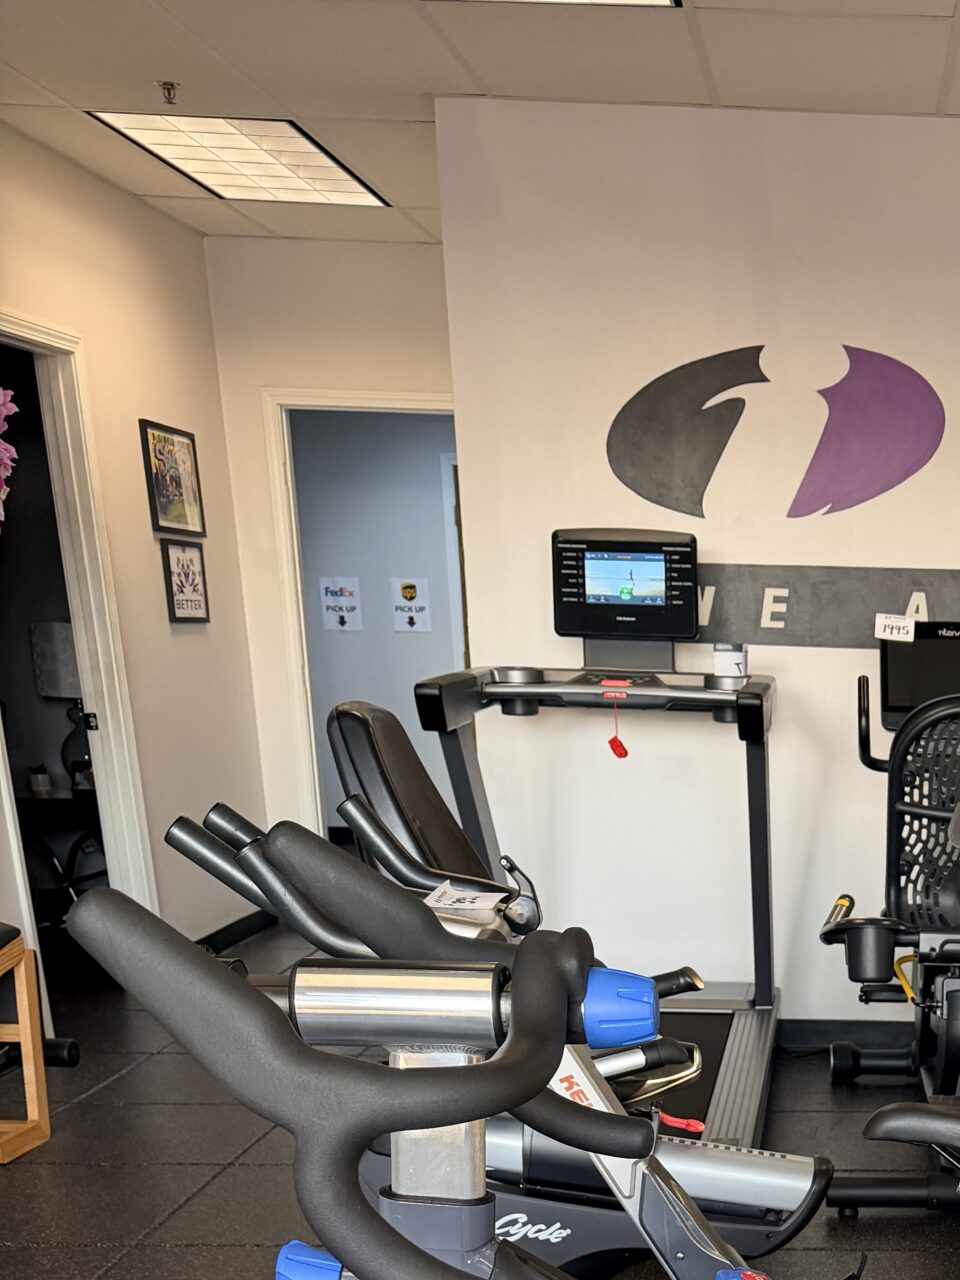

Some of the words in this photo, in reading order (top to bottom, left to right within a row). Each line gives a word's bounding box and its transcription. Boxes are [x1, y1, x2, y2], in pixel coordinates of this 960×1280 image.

[324, 586, 354, 598] FedEx
[175, 599, 203, 611] BETTER
[325, 605, 343, 613] PICK
[344, 605, 357, 613] UP
[394, 605, 413, 613] PICK
[414, 605, 426, 613] UP
[882, 623, 910, 636] 1995
[558, 1074, 594, 1109] KE
[494, 1212, 569, 1244] Cycle
